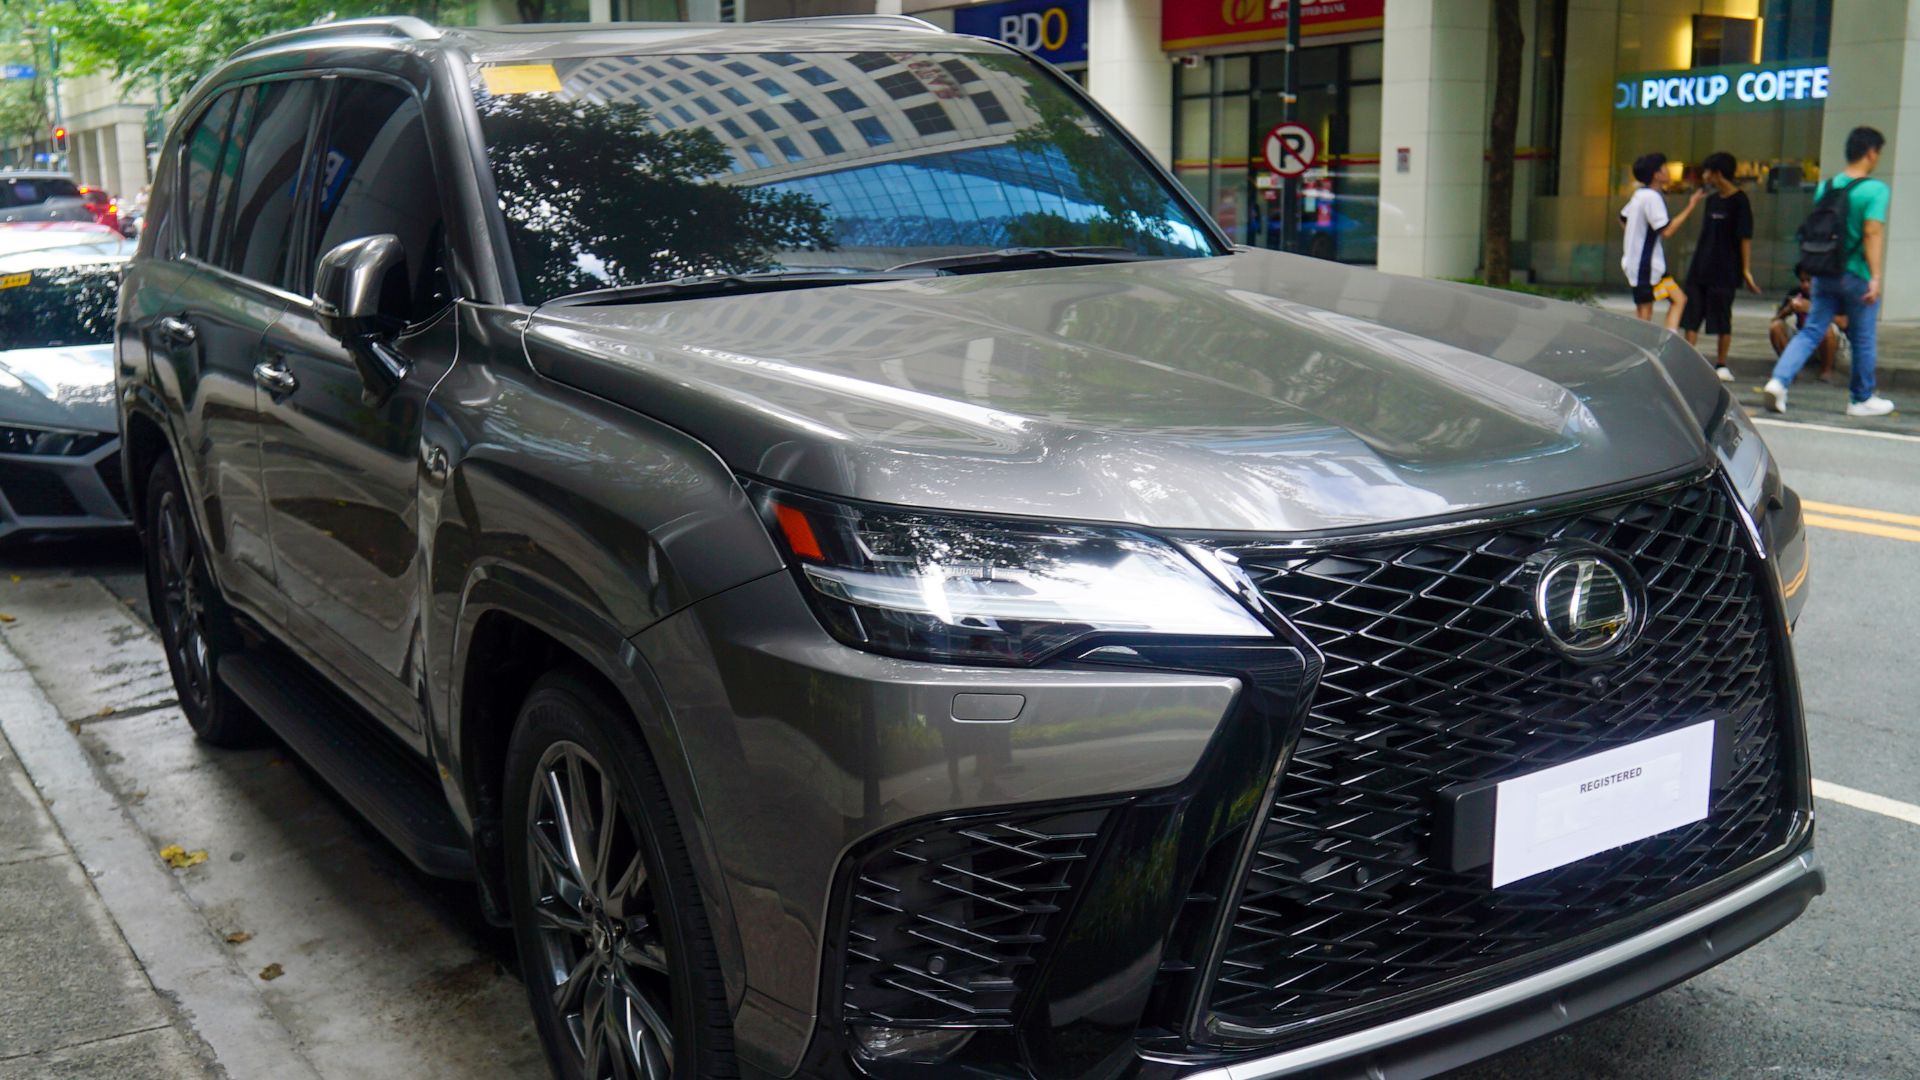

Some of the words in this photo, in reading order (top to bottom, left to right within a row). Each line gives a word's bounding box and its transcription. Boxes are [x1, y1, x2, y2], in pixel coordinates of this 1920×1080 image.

[1000, 7, 1068, 51] BDO
[1641, 75, 1729, 109] PICKUP
[1736, 67, 1829, 102] COFFE
[1580, 767, 1642, 793] REGISTERED
